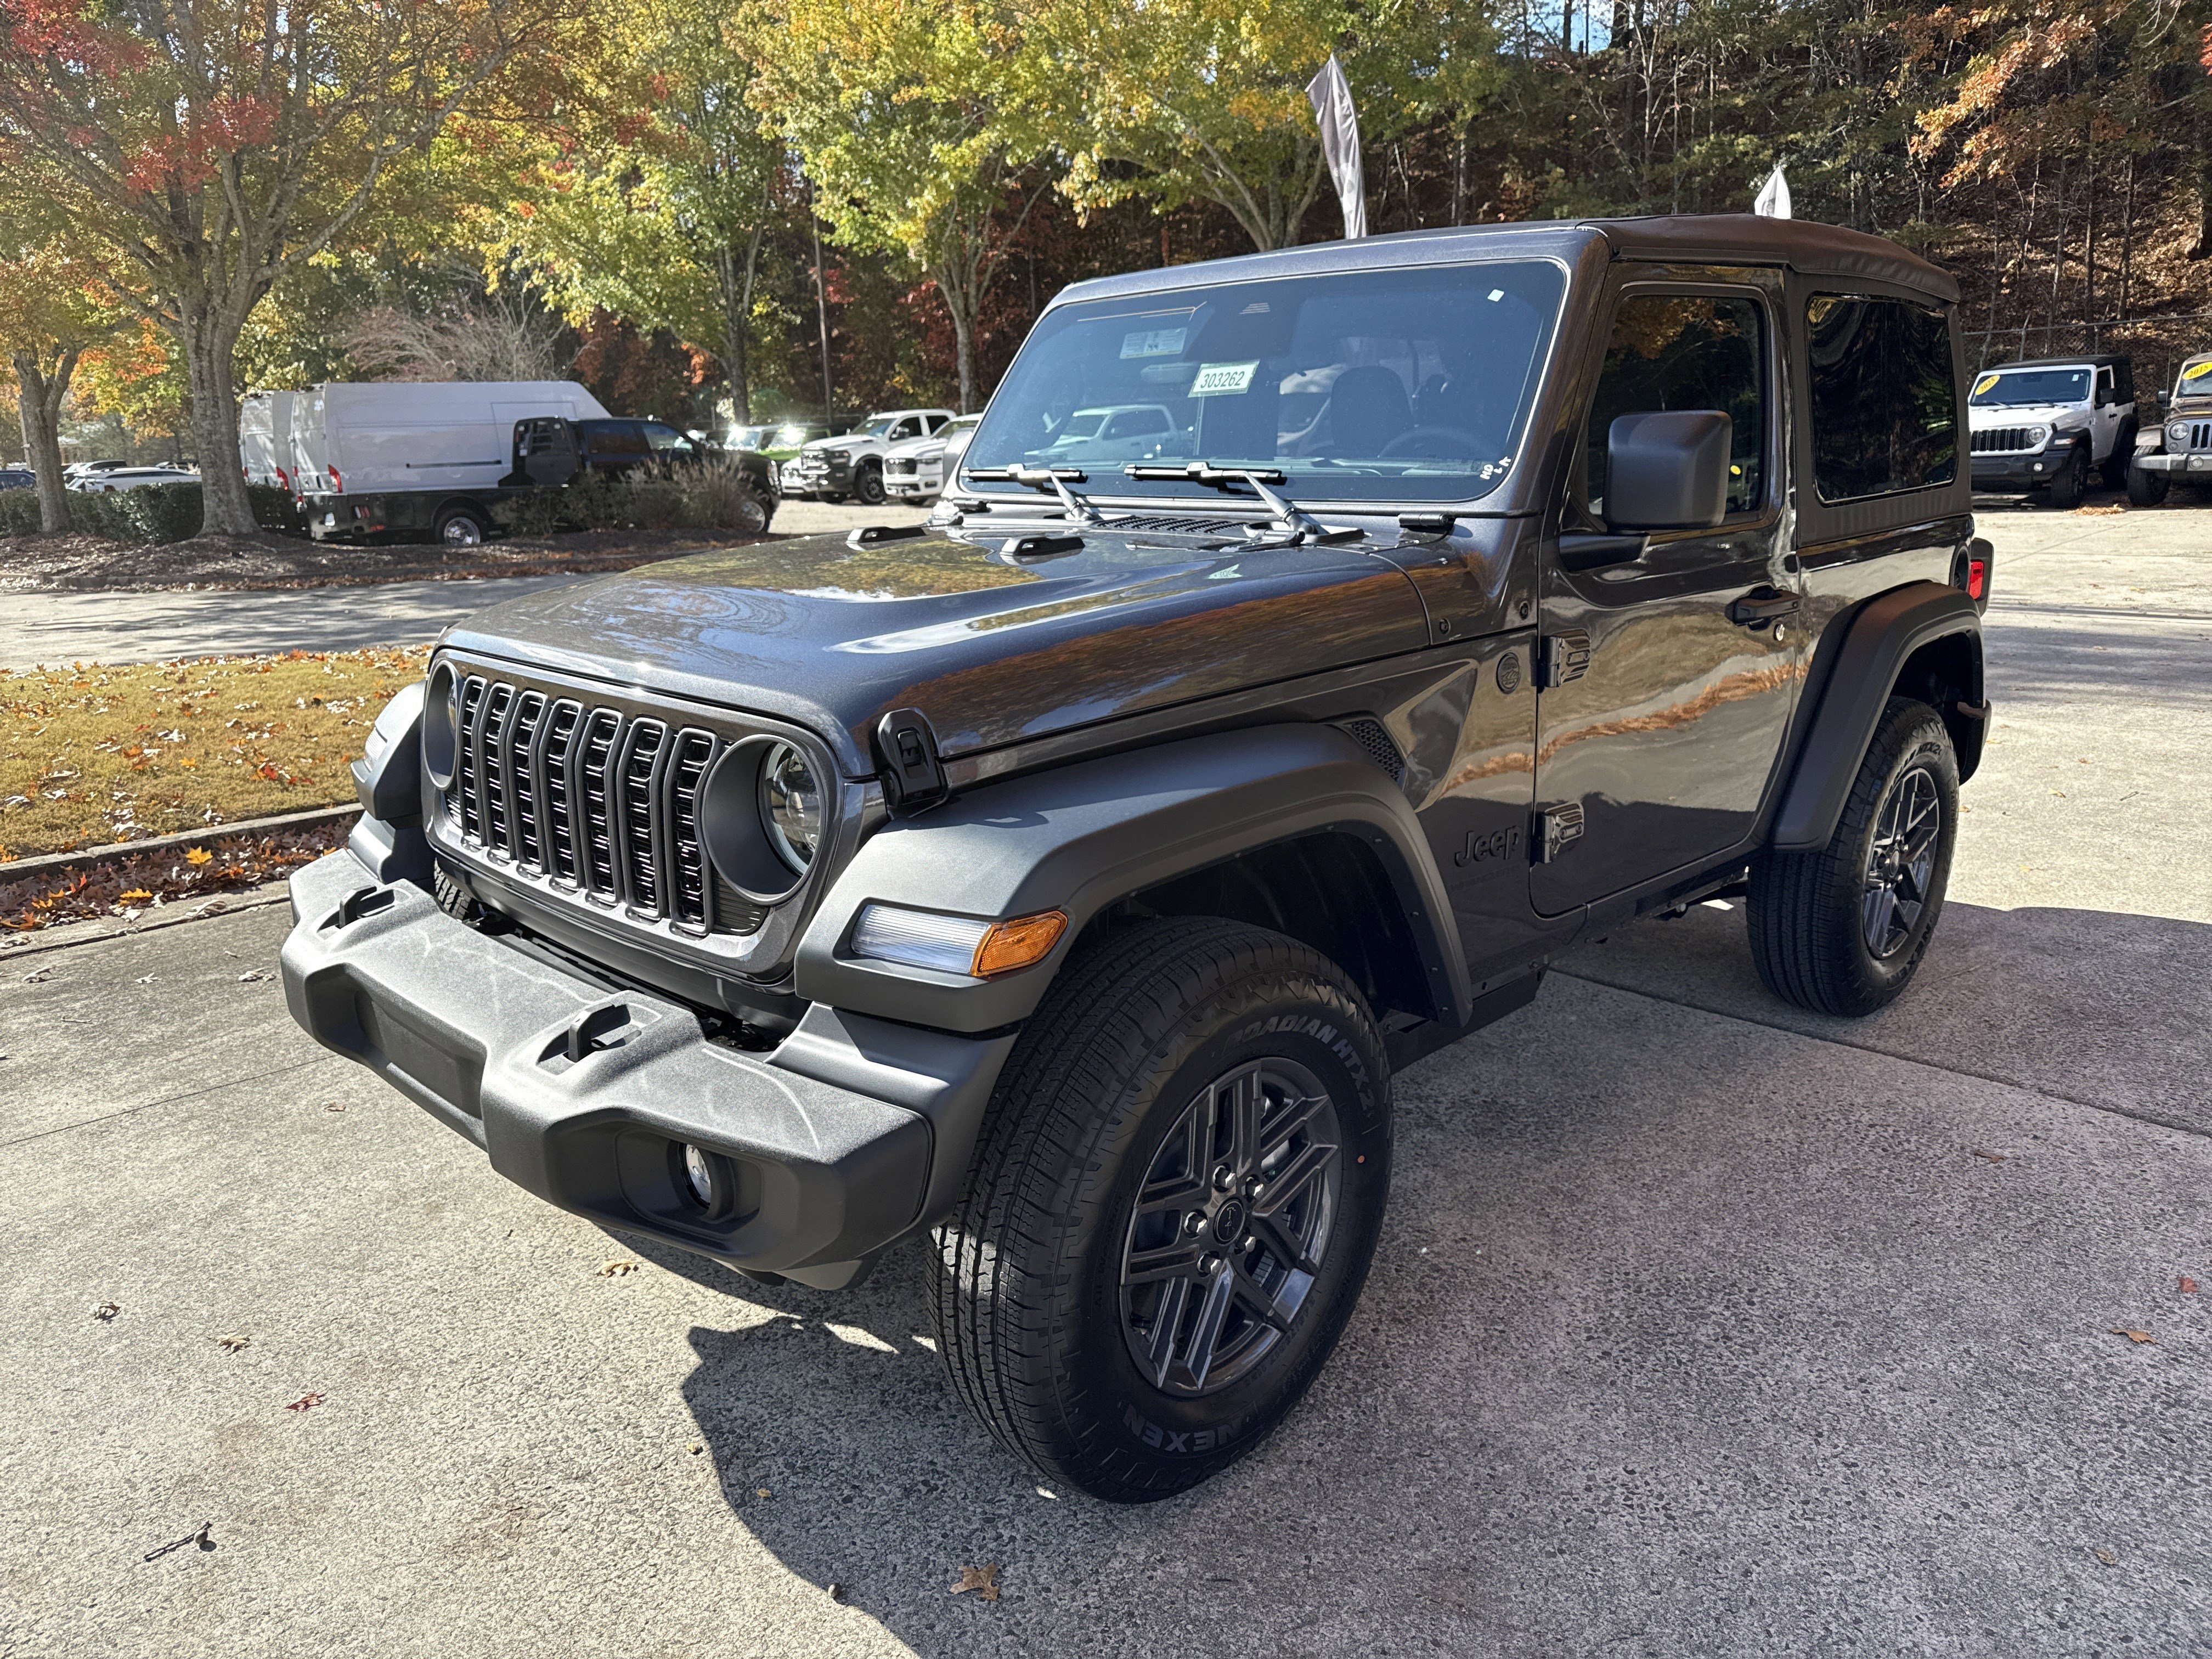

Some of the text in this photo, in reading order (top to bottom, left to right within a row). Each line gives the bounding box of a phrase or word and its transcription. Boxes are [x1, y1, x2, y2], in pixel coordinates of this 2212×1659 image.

[1200, 371, 1245, 388] 303262
[1454, 825, 1519, 867] Jeep
[1228, 1014, 1338, 1045] ROADIAN
[1123, 1403, 1243, 1453] NEXEN
